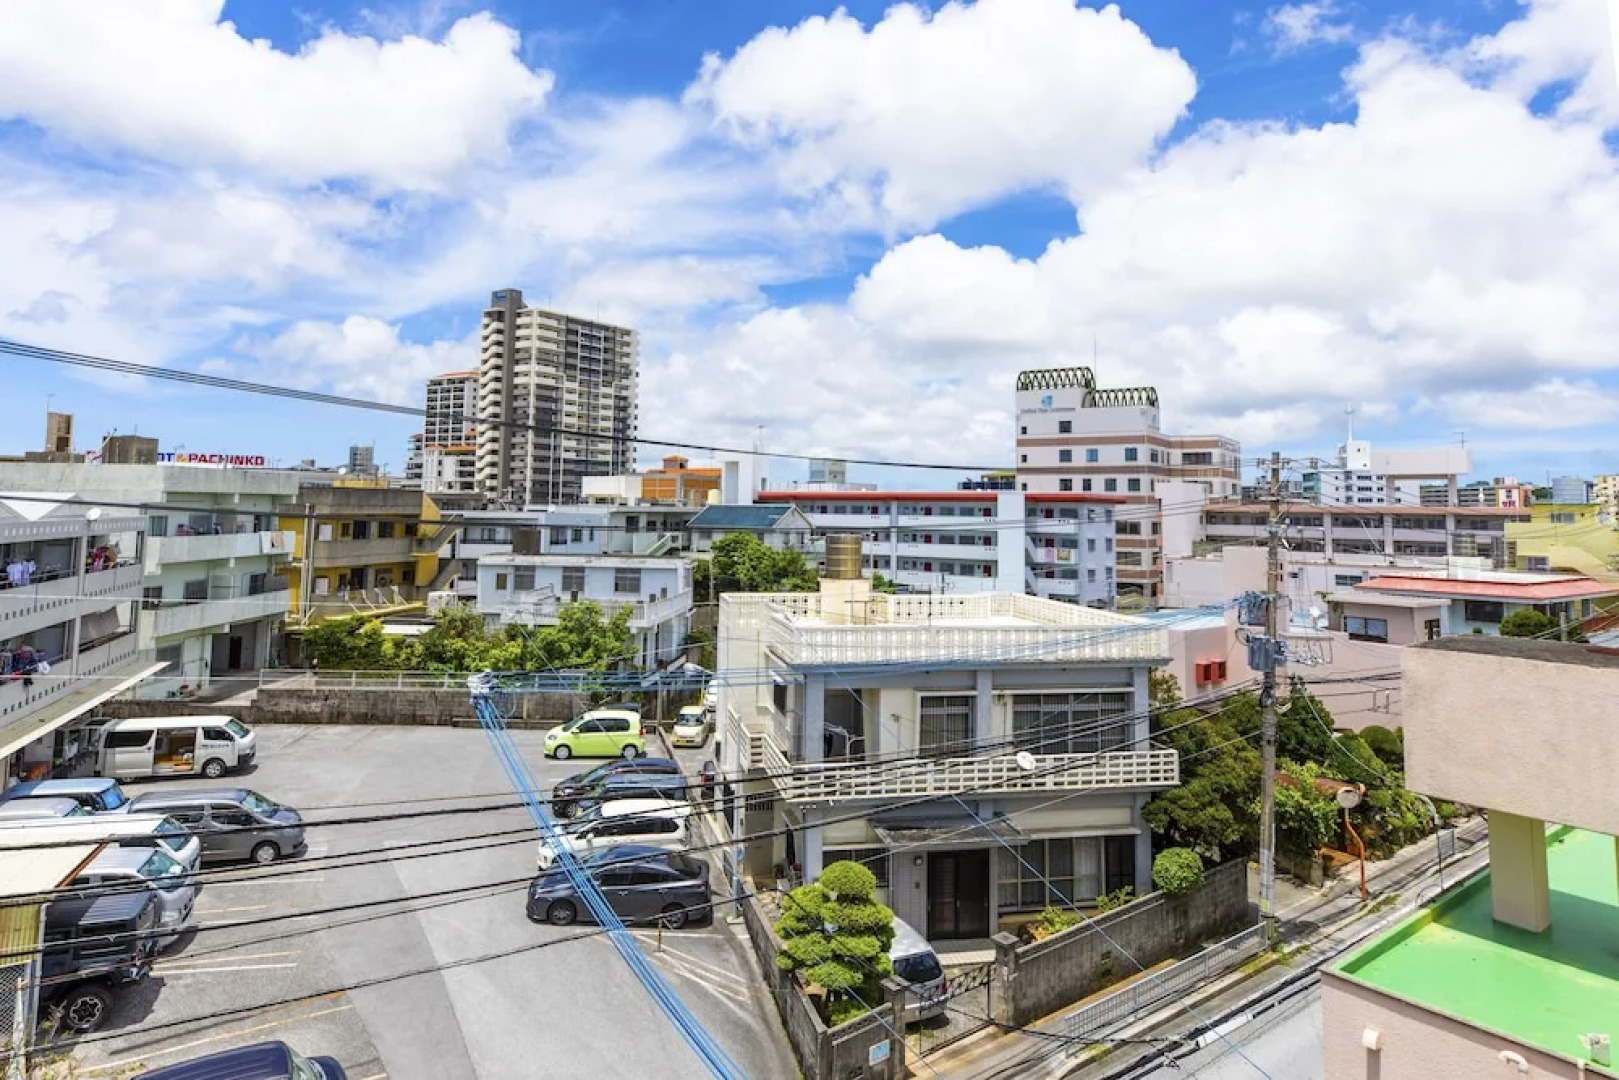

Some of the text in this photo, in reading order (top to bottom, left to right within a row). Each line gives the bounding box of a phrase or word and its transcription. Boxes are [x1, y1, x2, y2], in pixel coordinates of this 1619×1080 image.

[157, 453, 265, 466] OT & PACHINKO
